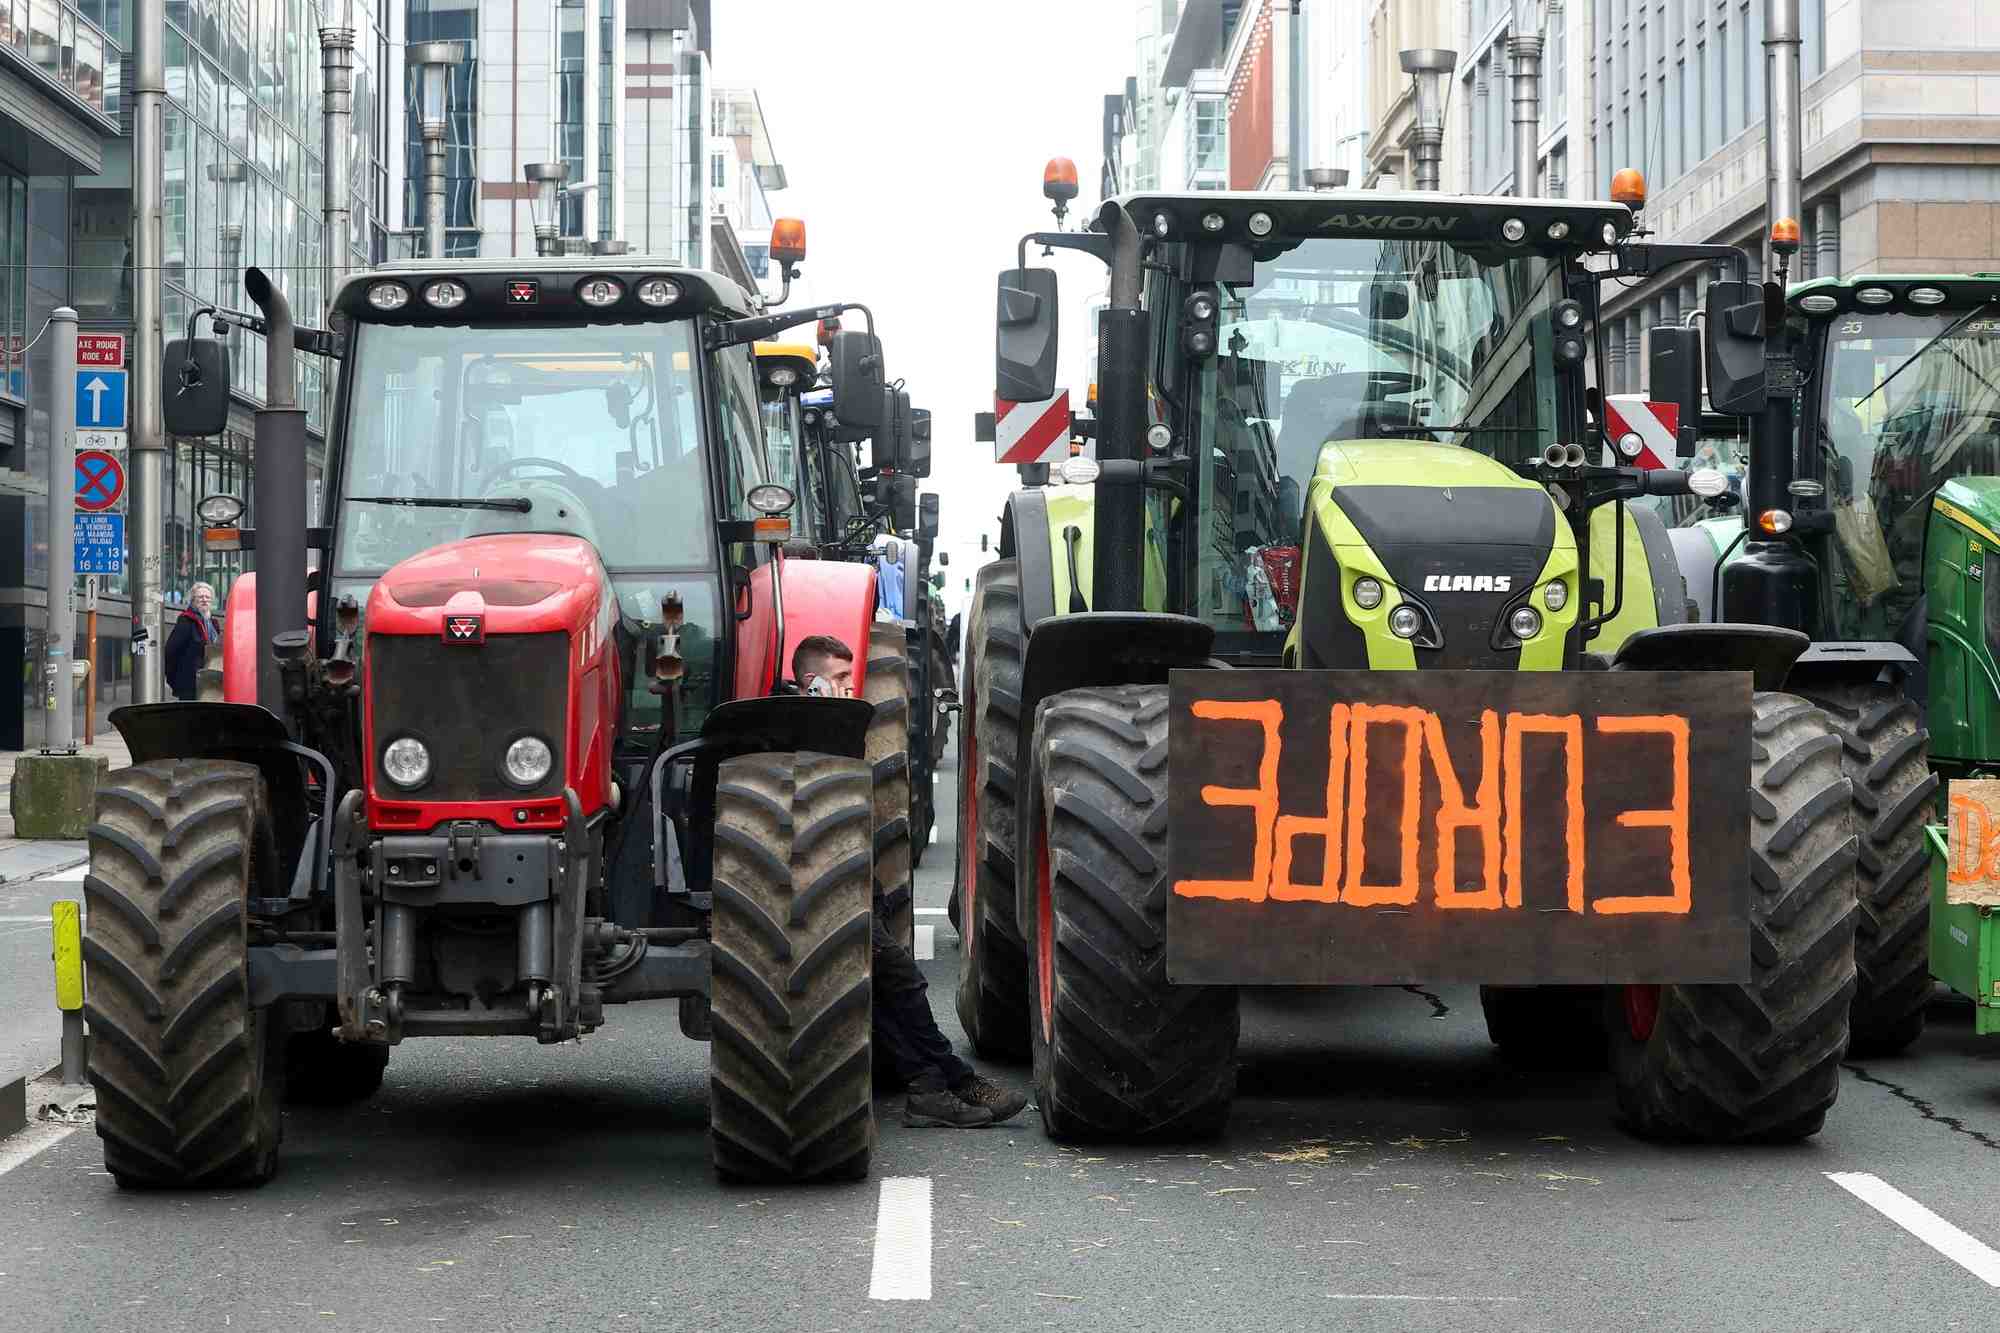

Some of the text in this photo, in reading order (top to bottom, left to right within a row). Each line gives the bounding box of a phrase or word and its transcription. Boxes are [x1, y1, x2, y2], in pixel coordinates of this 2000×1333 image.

[1317, 214, 1460, 231] AXION
[79, 340, 119, 350] AXE ROUGE
[82, 351, 114, 361] RODE AS
[82, 547, 89, 558] 7
[109, 547, 120, 558] 13
[80, 560, 91, 571] 16
[109, 560, 120, 571] 18
[1423, 575, 1512, 592] CLAAS
[1173, 699, 1691, 914] EUROPE
